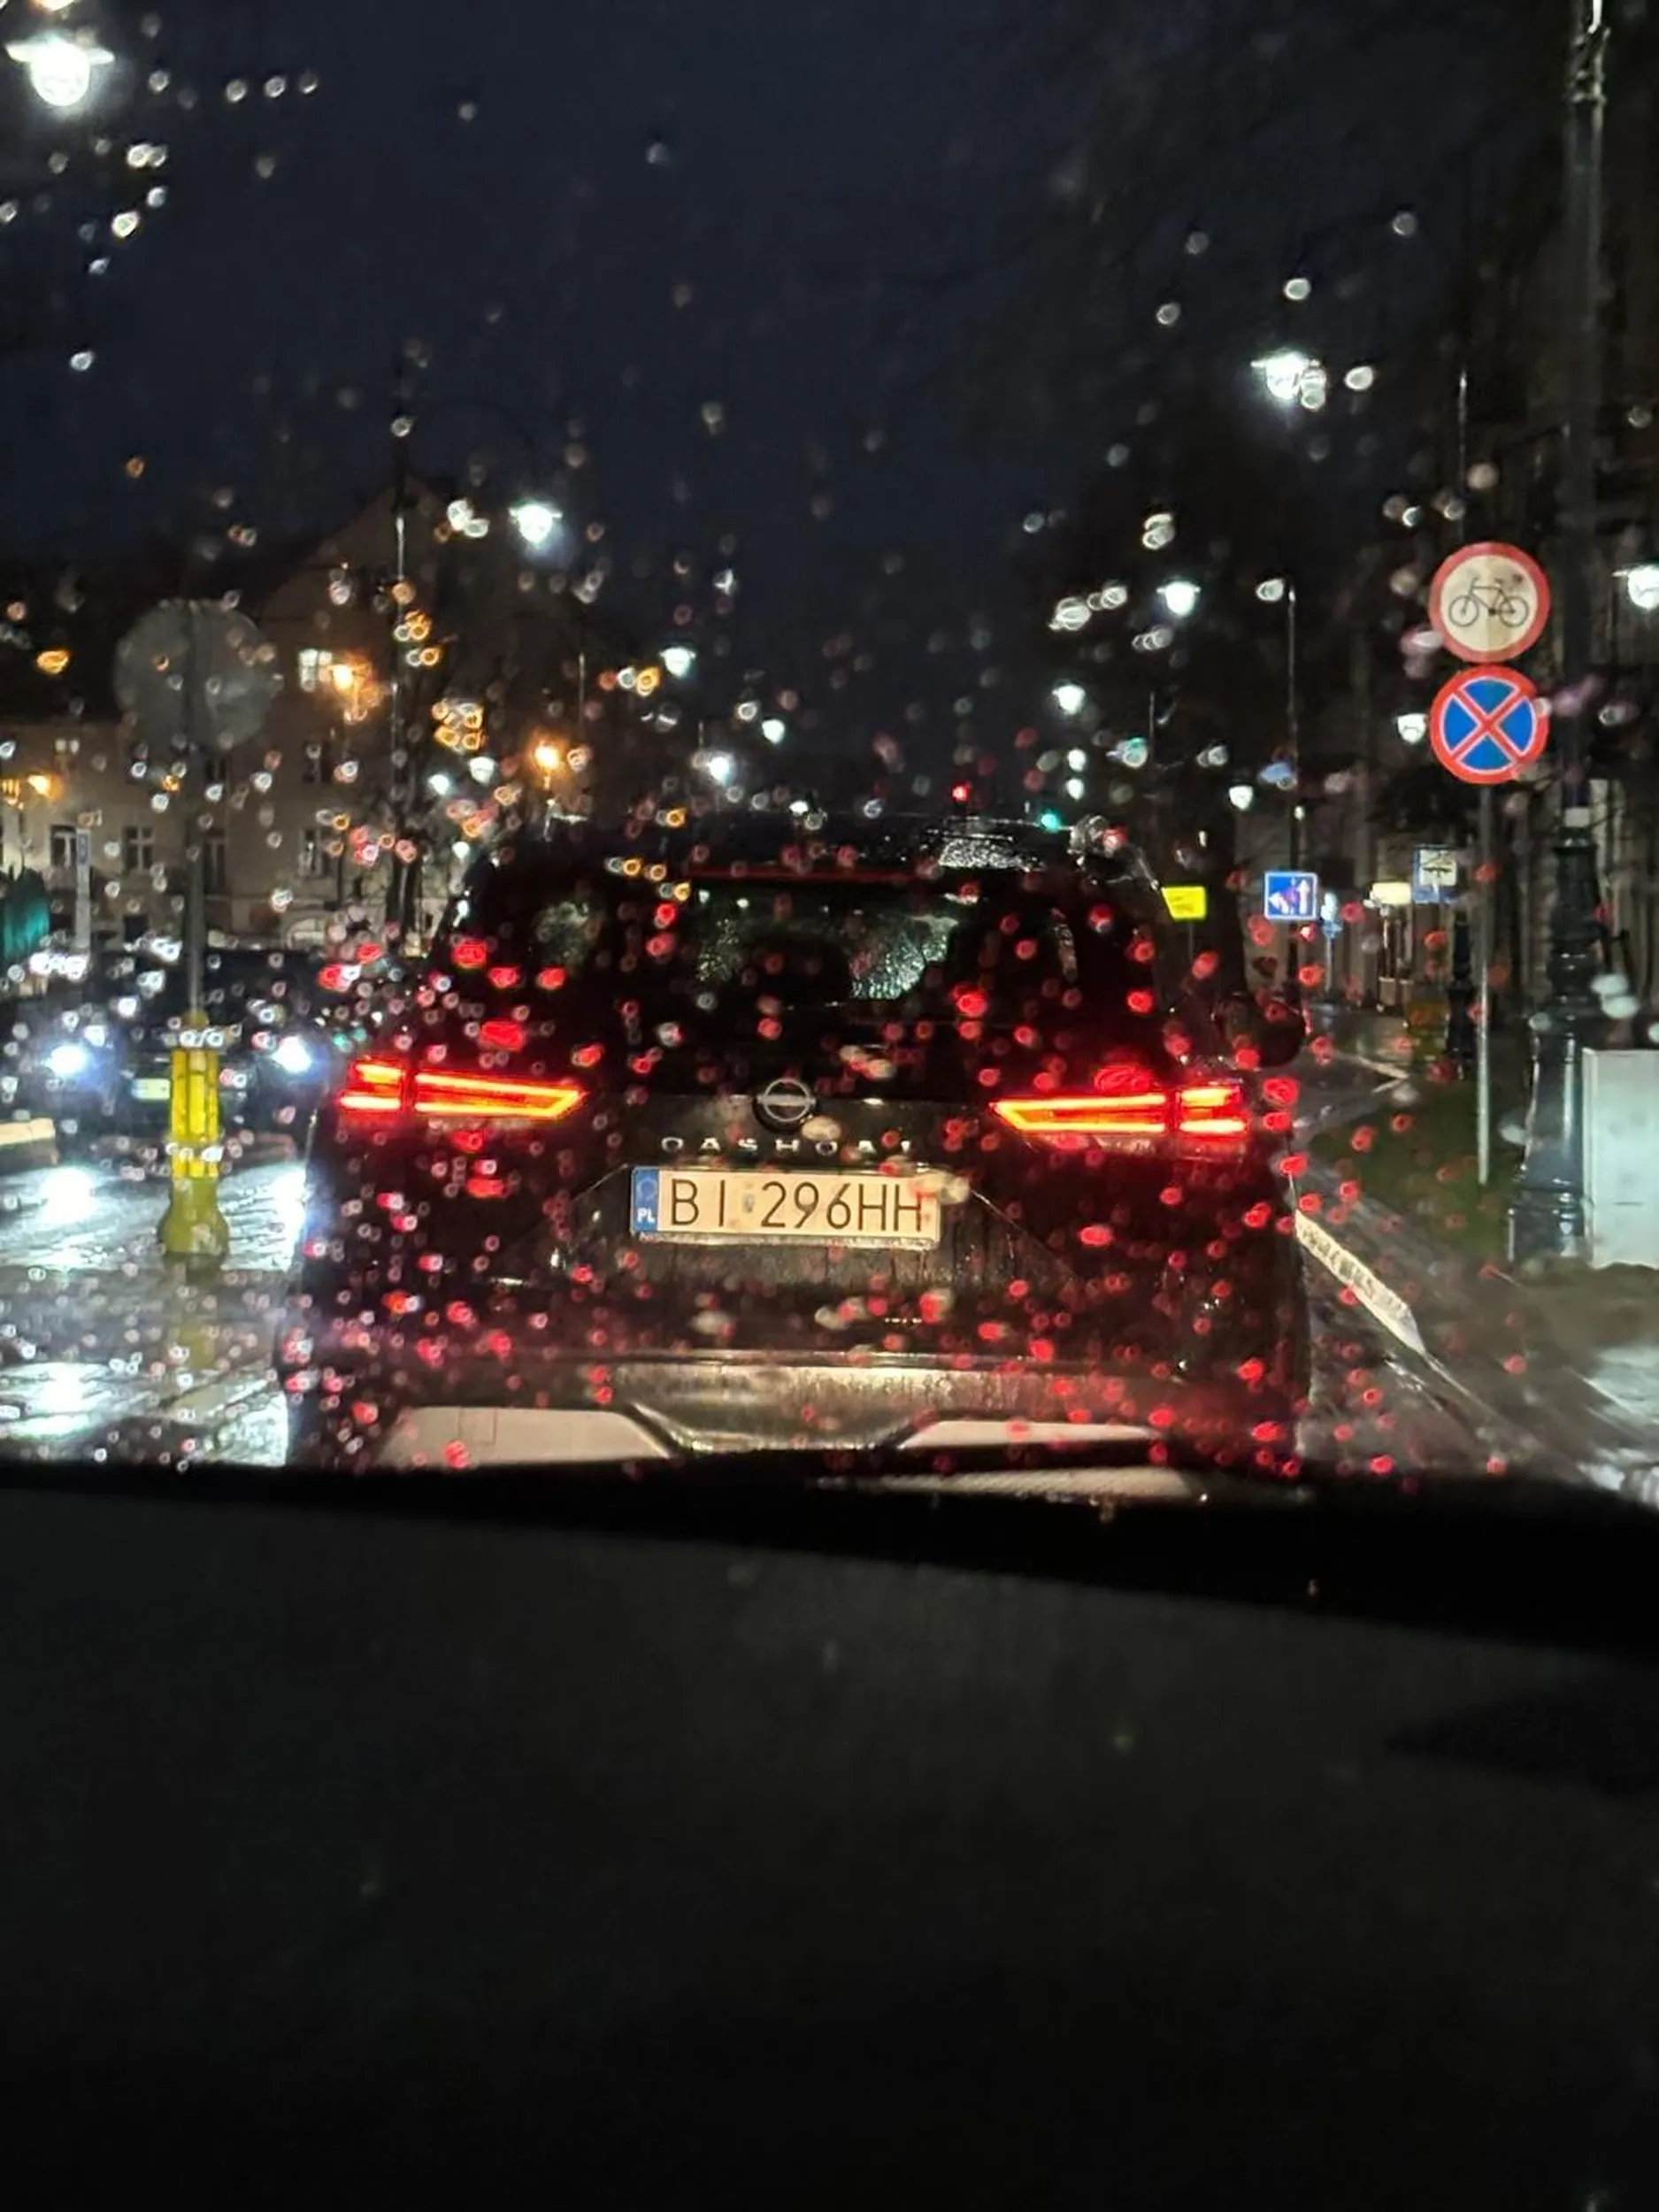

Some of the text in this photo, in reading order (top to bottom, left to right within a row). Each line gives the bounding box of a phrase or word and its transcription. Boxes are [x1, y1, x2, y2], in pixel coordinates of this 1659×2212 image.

[637, 1207, 656, 1224] PL
[671, 1178, 922, 1233] BI 296HH
